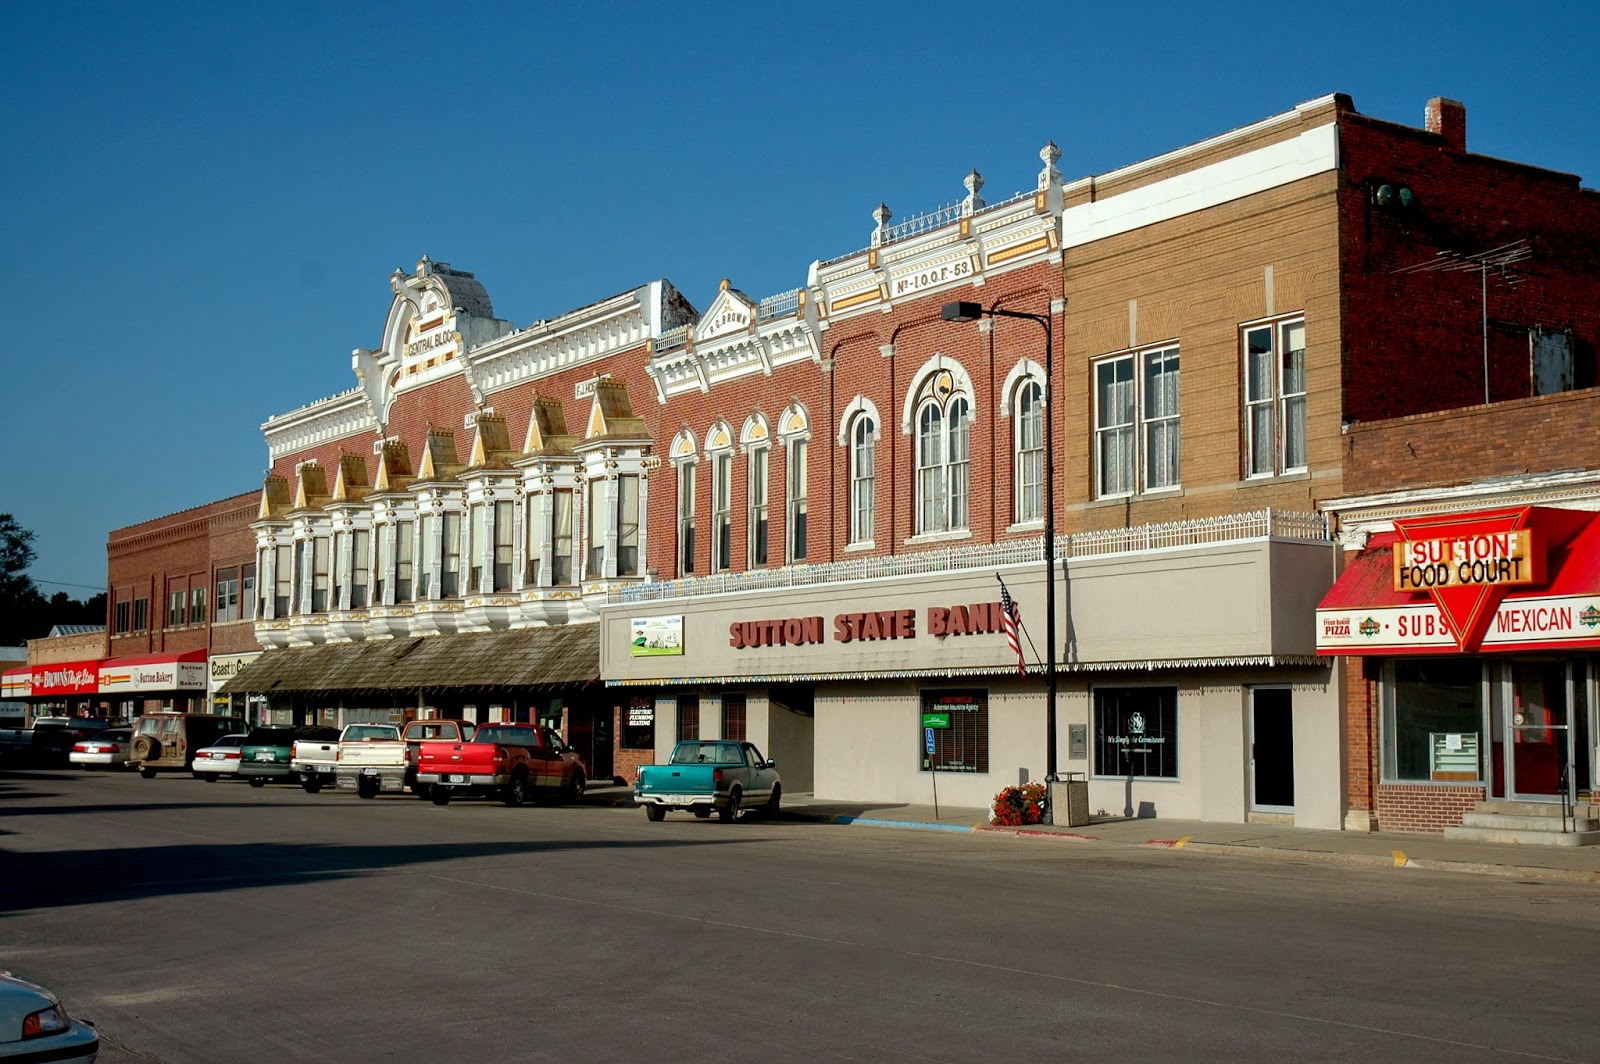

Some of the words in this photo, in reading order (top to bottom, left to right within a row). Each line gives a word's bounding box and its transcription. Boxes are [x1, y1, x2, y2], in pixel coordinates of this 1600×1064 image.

[409, 336, 434, 356] CENTRAL
[435, 330, 453, 347] BLOC
[1413, 535, 1509, 564] SUTTON
[1400, 563, 1449, 588] FOOD
[1458, 556, 1523, 584] COURT
[729, 616, 824, 649] SUTTON
[833, 609, 916, 642] STATE
[1325, 625, 1351, 636] PIZZA
[1398, 614, 1449, 637] SUBS
[1497, 606, 1572, 633] MEXICAN
[139, 673, 155, 684] Sutton
[156, 671, 174, 684] Bakery
[211, 660, 230, 677] Coast
